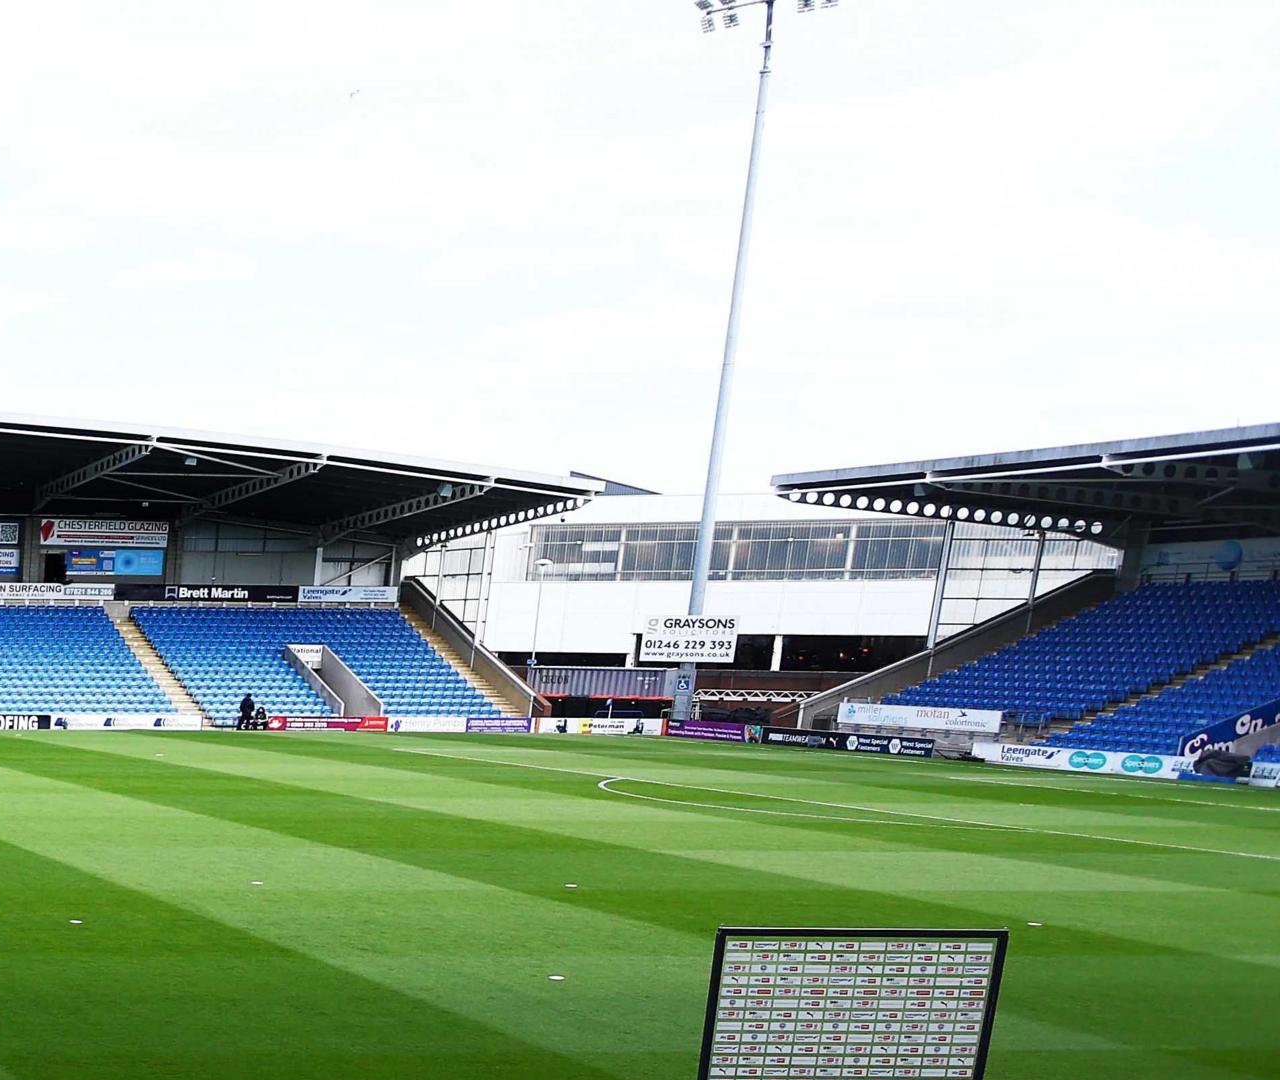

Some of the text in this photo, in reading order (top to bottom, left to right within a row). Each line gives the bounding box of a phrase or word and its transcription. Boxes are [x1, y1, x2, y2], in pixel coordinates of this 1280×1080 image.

[57, 520, 168, 532] CHESTERFIELD GLAZING
[8, 584, 62, 593] SURFACING
[179, 587, 248, 599] Brett Martin
[302, 588, 341, 596] Leengate
[663, 618, 735, 629] GRAYSONS
[645, 640, 732, 650] 01246 229 393
[857, 705, 882, 715] miller
[916, 708, 950, 719] motan
[589, 722, 625, 730] Peterman
[945, 717, 988, 728] colortronic
[859, 737, 871, 745] West
[1001, 745, 1048, 758] Leengate
[1000, 753, 1023, 763] Valves
